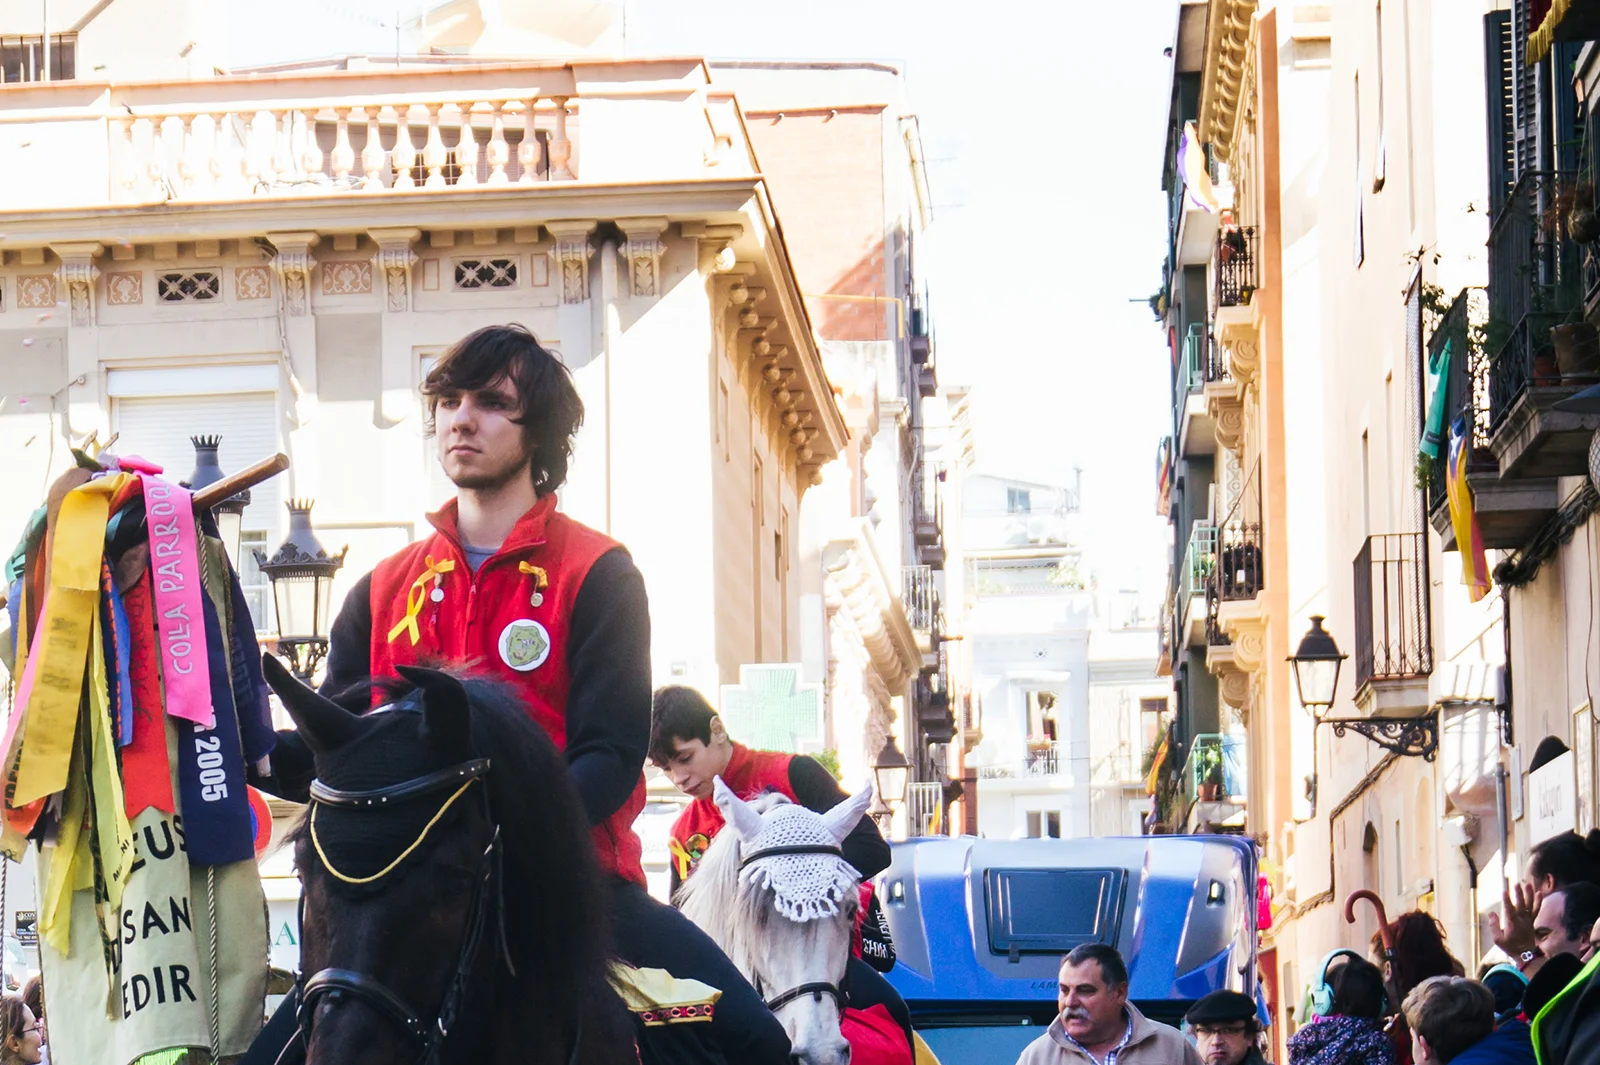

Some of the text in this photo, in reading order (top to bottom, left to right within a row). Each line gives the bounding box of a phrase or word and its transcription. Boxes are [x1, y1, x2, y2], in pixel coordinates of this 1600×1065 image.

[151, 481, 193, 676] COLLA PARROQ
[194, 736, 228, 803] 2005
[130, 814, 188, 873] EUS
[123, 896, 191, 945] SAN
[122, 964, 197, 1020] EDIR
[1030, 980, 1059, 990] LAM
